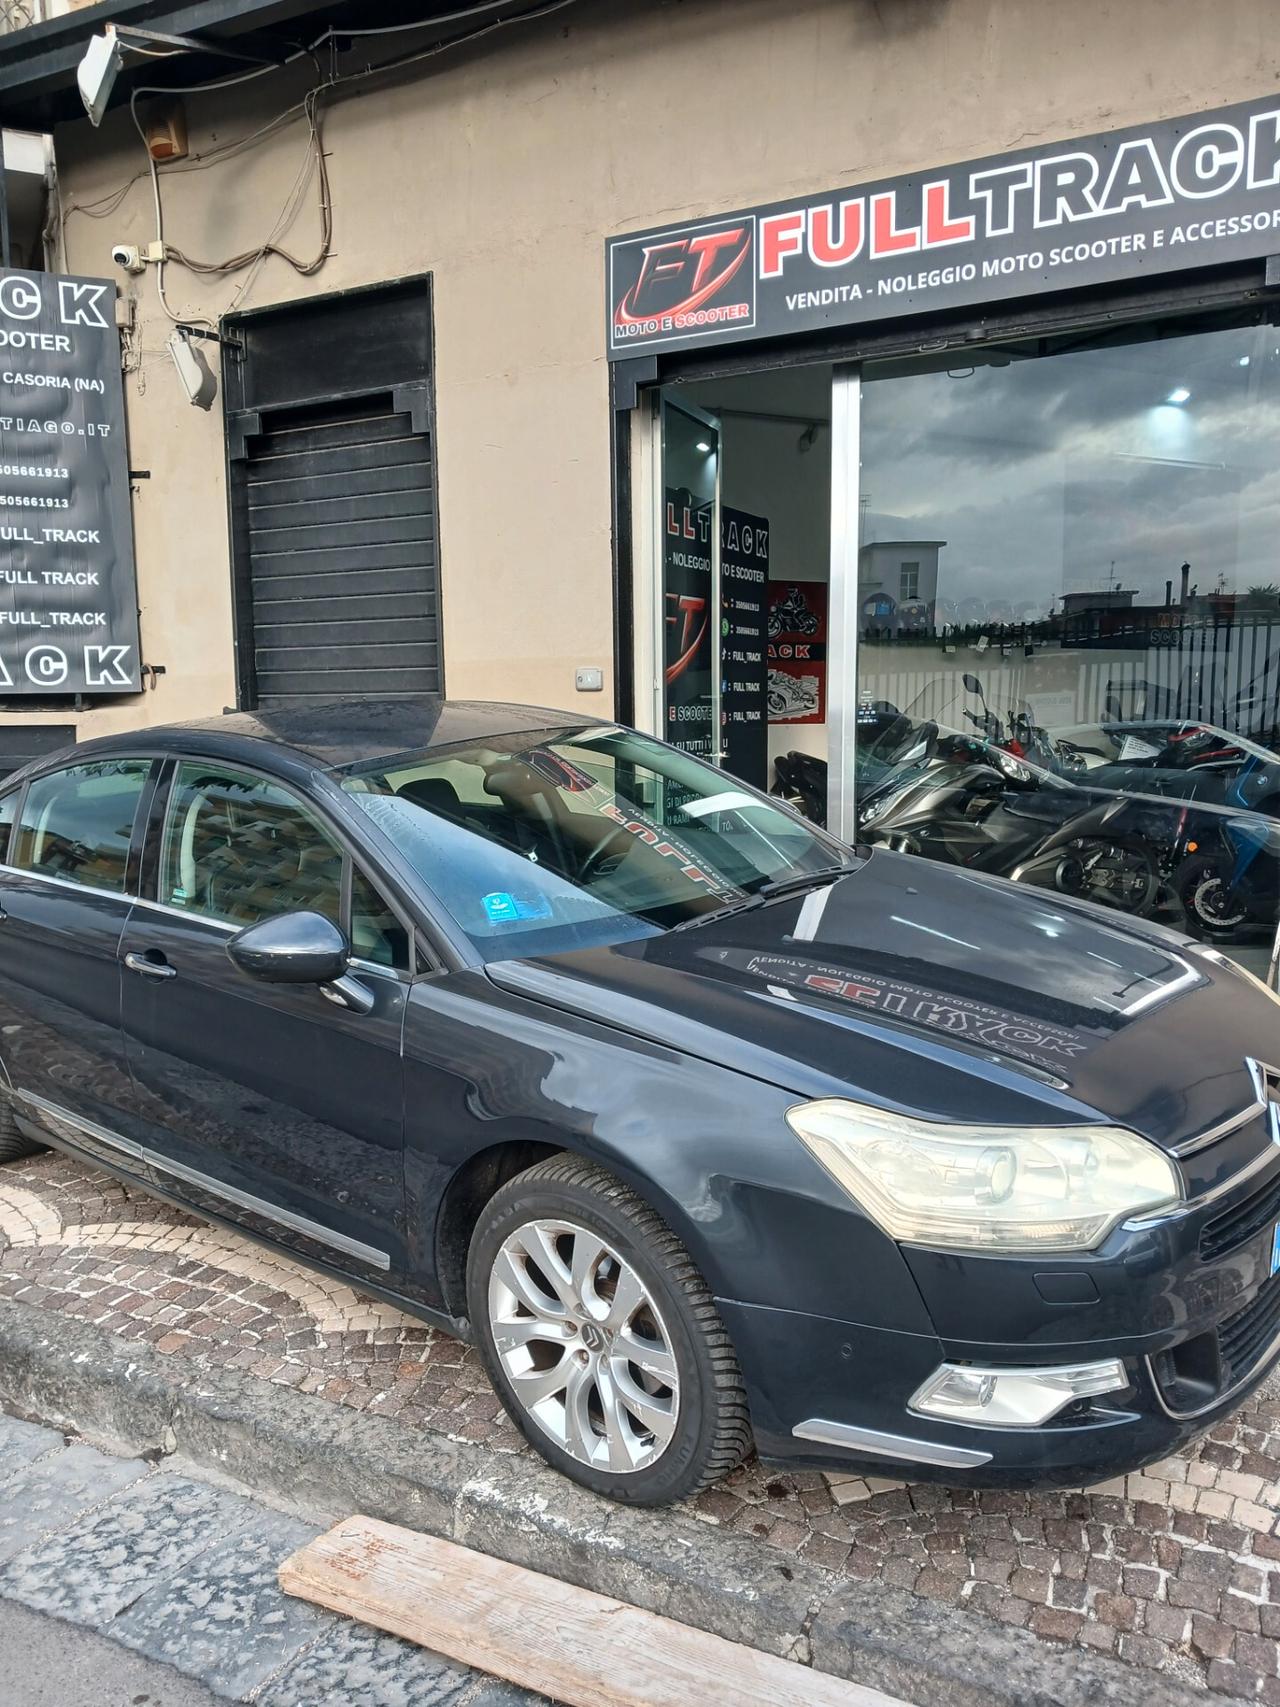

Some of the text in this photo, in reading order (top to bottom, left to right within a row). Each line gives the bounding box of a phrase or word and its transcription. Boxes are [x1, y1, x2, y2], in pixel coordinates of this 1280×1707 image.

[785, 284, 863, 310] VENDITA
[877, 263, 976, 296] NOLEGGIO
[982, 251, 1044, 278] MOTO
[1049, 233, 1147, 266] SCOOTER
[1153, 229, 1164, 248] E
[0, 276, 109, 328] CK
[615, 303, 750, 337] MOTO E SCOOTER
[3, 372, 105, 395] CASORIA (NA)
[0, 417, 110, 437] TIAGO.IT
[0, 527, 100, 544] ULL_TRACK
[673, 552, 710, 572] NOLEGGIO
[736, 565, 765, 584] SCOOTER
[41, 571, 100, 586] TRACK
[0, 611, 106, 628] FULL_TRACK
[0, 644, 132, 686] CK
[733, 652, 762, 662] FULL_TRACK
[733, 682, 745, 692] FULL
[746, 682, 760, 692] TRACK
[669, 705, 712, 721] E SCOOTE
[733, 710, 761, 722] FULL_TRACK
[686, 740, 704, 751] TUTTI
